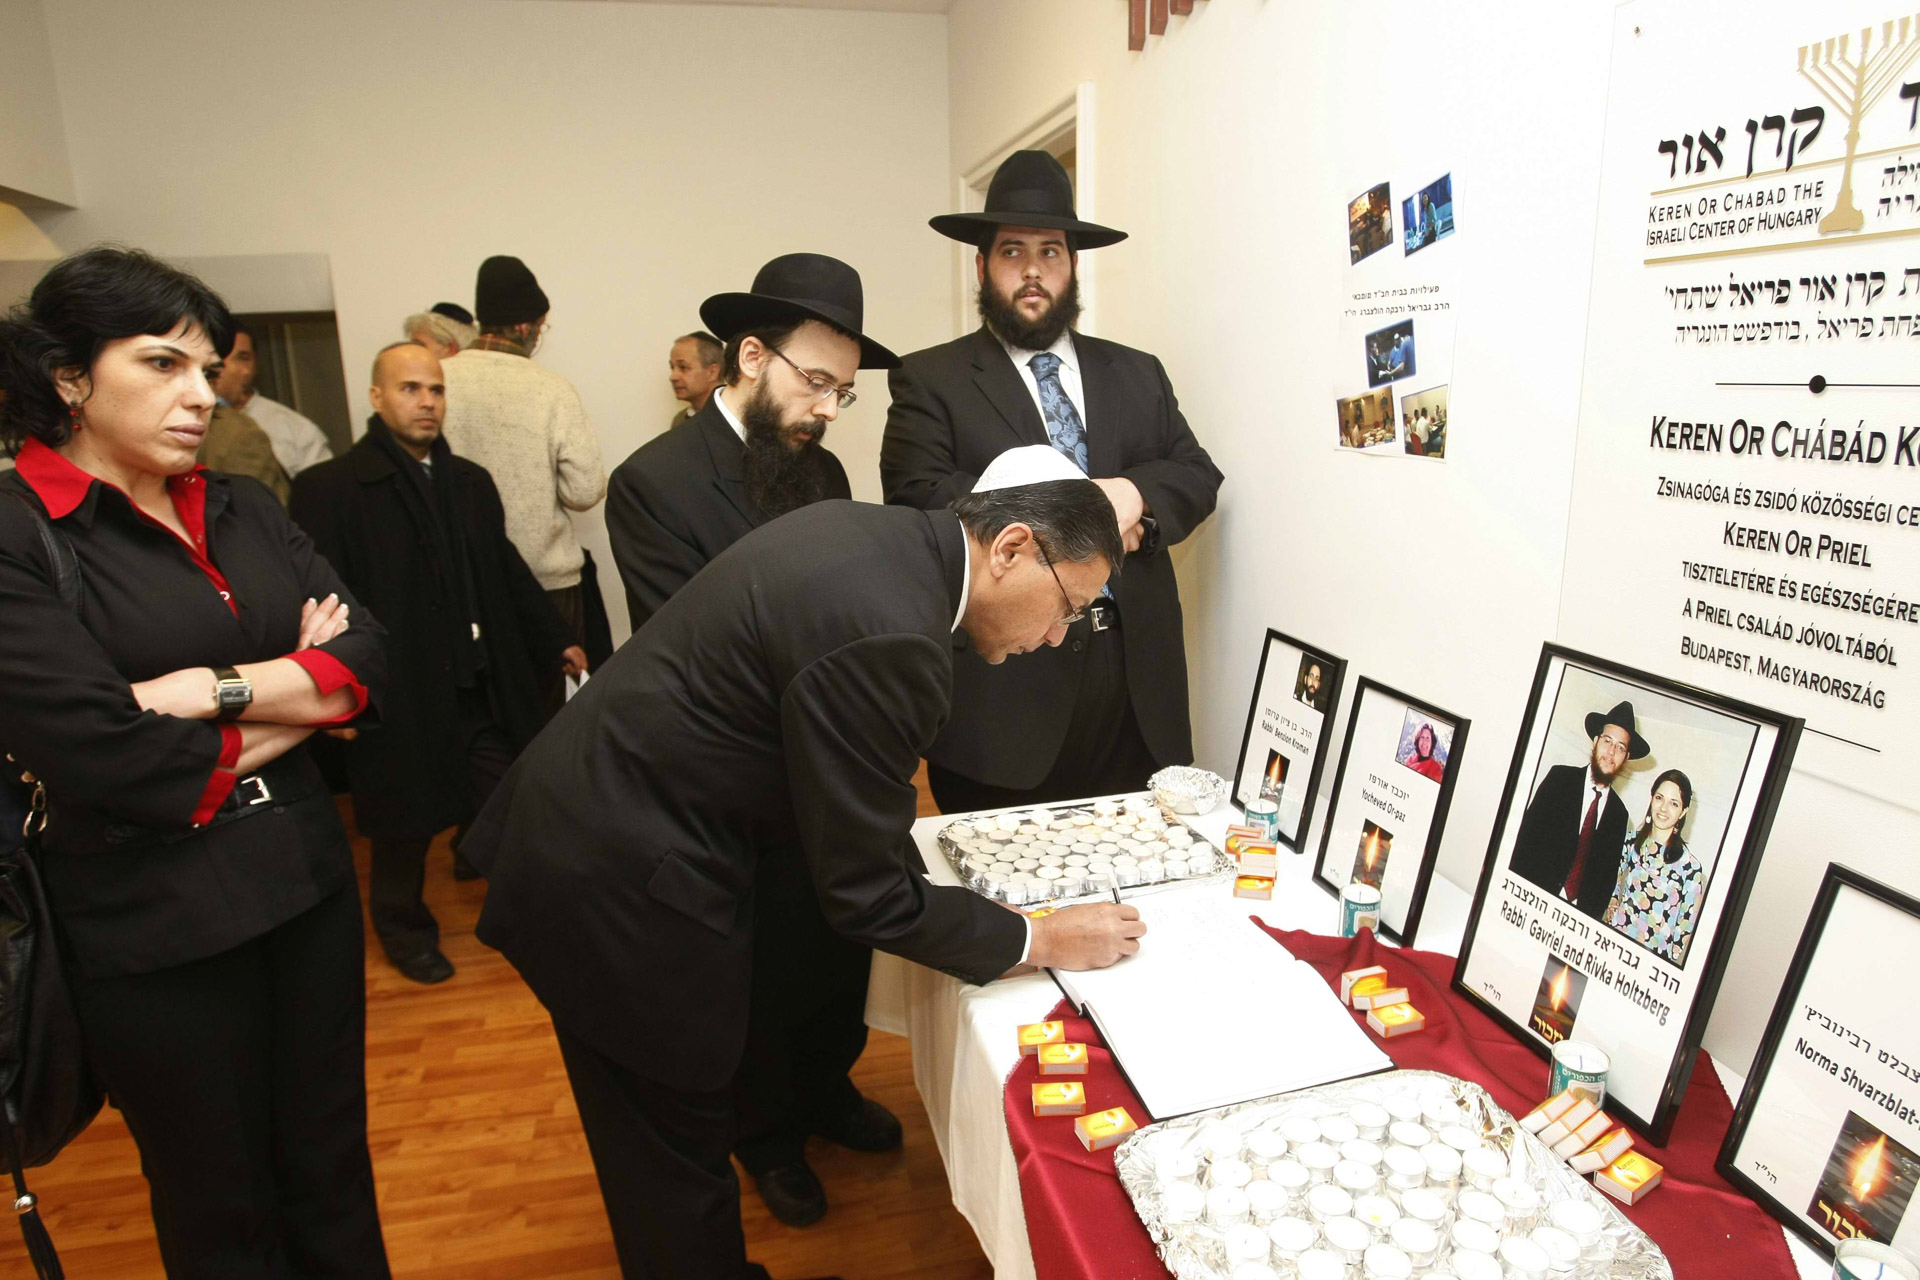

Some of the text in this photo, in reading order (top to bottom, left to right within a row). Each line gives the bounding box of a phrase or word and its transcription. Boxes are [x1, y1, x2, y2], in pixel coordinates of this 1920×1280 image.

[1658, 125, 1727, 179] אור
[1745, 106, 1825, 179] קרן
[1882, 156, 1920, 187] ילה
[1794, 180, 1825, 201] THE
[1877, 194, 1920, 218] ריה
[1738, 216, 1755, 233] OF
[1434, 302, 1450, 311] הרב
[1729, 272, 1791, 307] פריאל
[1799, 274, 1837, 302] אור
[1845, 270, 1885, 307] קרן
[1675, 324, 1728, 343] הונגריה
[1733, 320, 1800, 342] בודפשט
[1894, 426, 1920, 466] K
[1734, 482, 1751, 506] ÉS
[1754, 487, 1797, 512] ZSIDÓ
[1800, 490, 1892, 523] KÖZÖSSÉGI
[1682, 561, 1775, 595] TISZTELETÉRE
[1778, 573, 1798, 599] ÉS
[1682, 598, 1692, 618] A
[1737, 613, 1793, 641] CSALÁD
[1795, 622, 1898, 667] JÓVOLTÁBÓL
[1502, 878, 1681, 994] הרב גבריאל ורבקה הולצברג
[1500, 900, 1670, 1026] Rabbi Gavriel and Rivka Holtzberg
[1794, 1037, 1920, 1131] Norma Shvarzblat-
